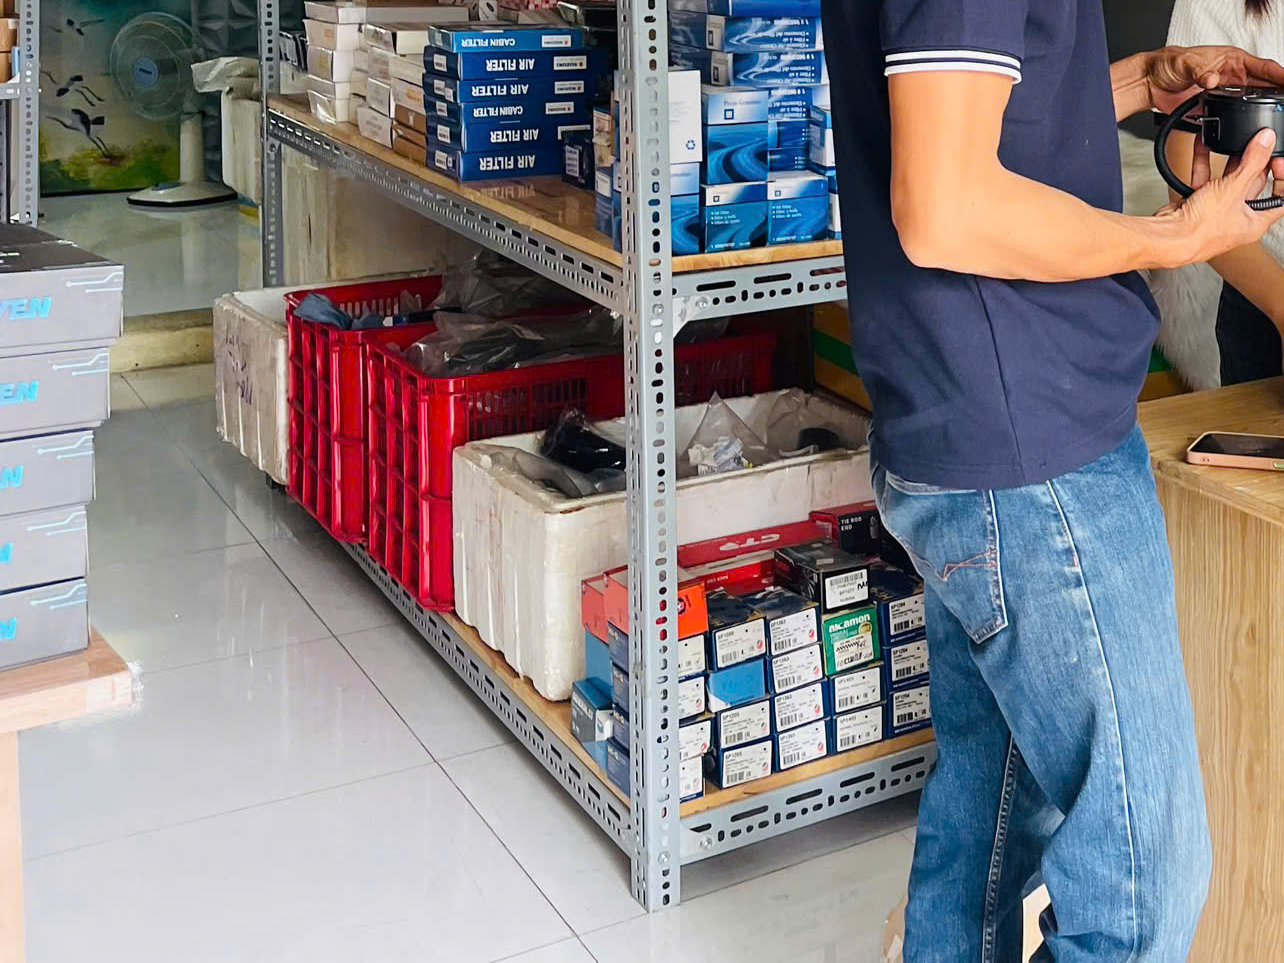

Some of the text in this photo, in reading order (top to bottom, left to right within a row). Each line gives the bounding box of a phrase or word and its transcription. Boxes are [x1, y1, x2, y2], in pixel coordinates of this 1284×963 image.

[461, 38, 515, 47] CABIN FILTER
[486, 58, 535, 72] AIR FILTER
[471, 83, 529, 97] AIR FILTER
[473, 105, 523, 117] CABIN FILTER
[490, 128, 539, 143] AIR FILTER
[479, 155, 536, 171] AIR FILTER
